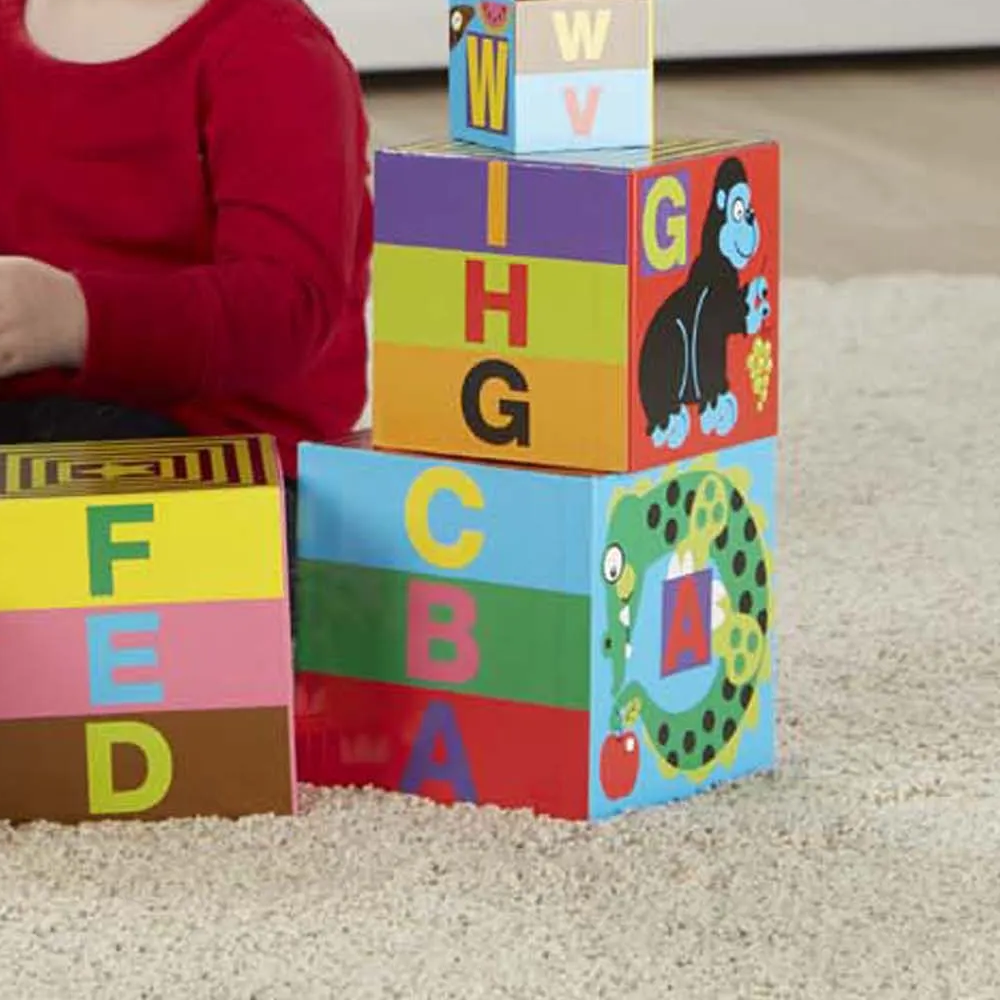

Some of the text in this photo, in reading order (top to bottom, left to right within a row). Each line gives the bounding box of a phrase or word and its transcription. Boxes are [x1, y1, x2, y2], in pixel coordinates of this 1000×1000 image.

[466, 34, 509, 131] W
[552, 8, 612, 62] W
[563, 84, 601, 137] V
[642, 175, 687, 271] G
[464, 260, 529, 348] H
[461, 359, 530, 447] G
[86, 503, 154, 597] F
[404, 466, 485, 569] C
[85, 611, 164, 707] E
[406, 580, 481, 684] B
[665, 575, 710, 671] A
[85, 720, 173, 814] D
[400, 700, 478, 804] A
